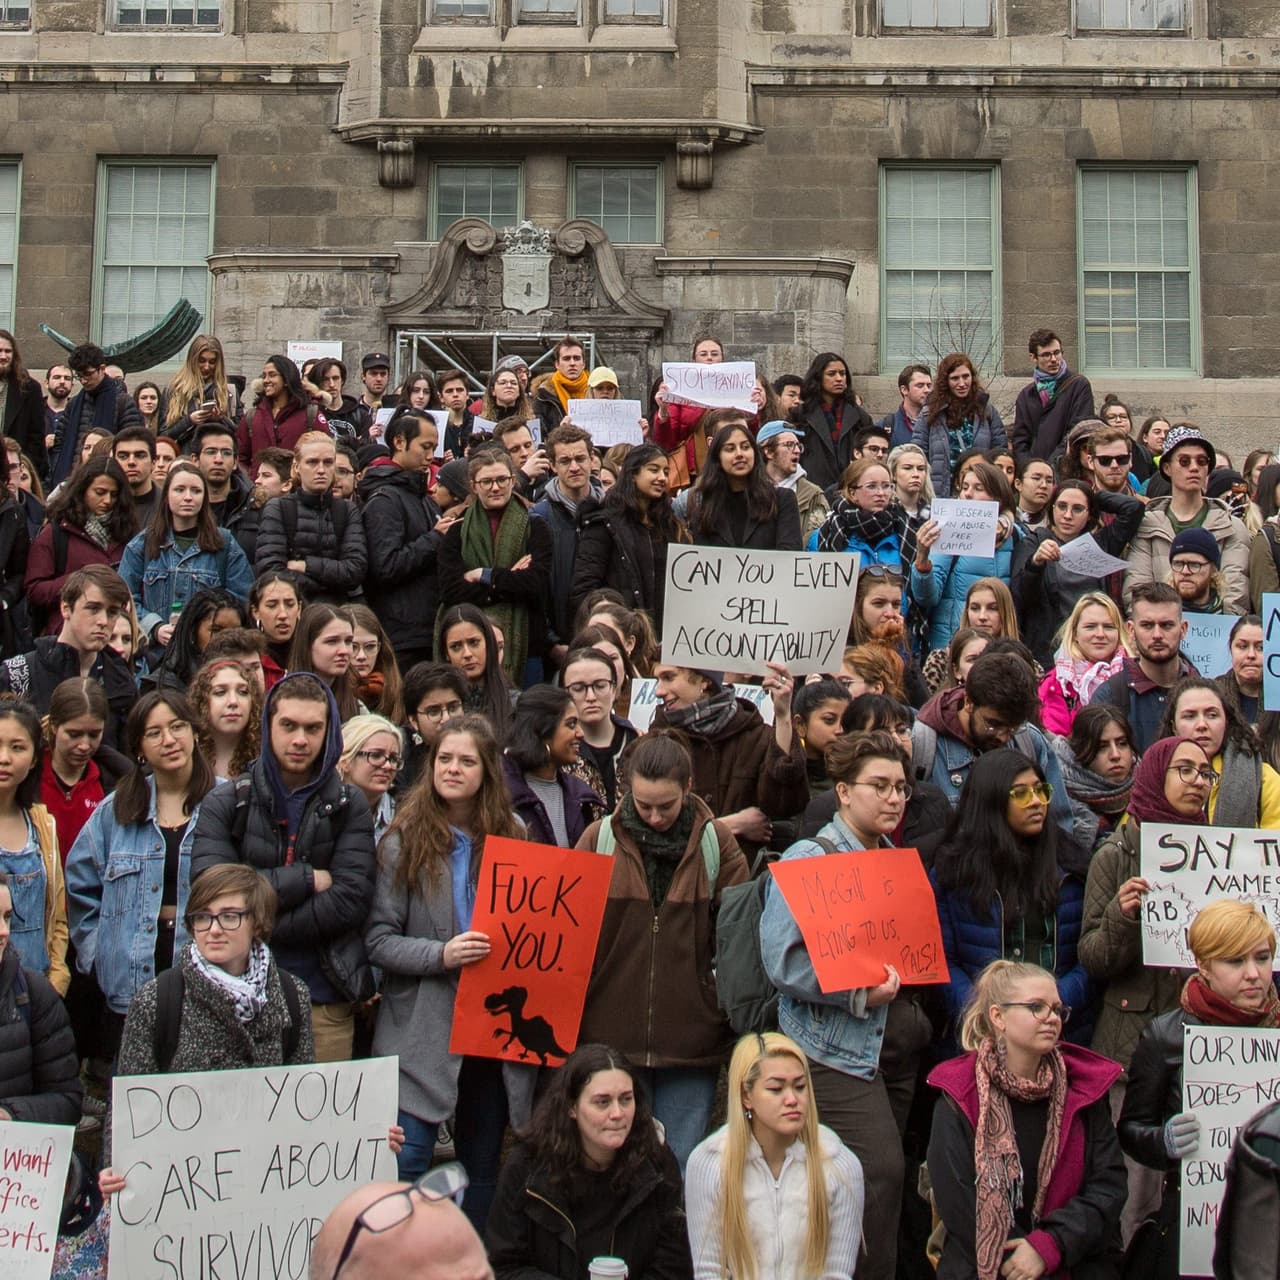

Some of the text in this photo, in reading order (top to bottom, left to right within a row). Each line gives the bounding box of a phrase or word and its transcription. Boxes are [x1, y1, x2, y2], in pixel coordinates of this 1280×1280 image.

[955, 508, 994, 519] DESERVE
[940, 542, 974, 551] CAMPUS
[671, 550, 855, 592] CAN YOU EVEN
[720, 596, 790, 626] SPELL
[671, 625, 841, 667] ACCOUNTABILITY
[1158, 833, 1235, 872] SAY
[490, 862, 582, 927] FUCK
[816, 923, 856, 960] LYING
[859, 920, 877, 945] TO
[900, 943, 938, 976] PALS!
[1189, 1035, 1235, 1066] OUR
[127, 1070, 363, 1139] DO YOU
[1186, 1083, 1241, 1109] DOES
[4, 1145, 52, 1177] want
[1186, 1160, 1227, 1187] SEXU
[117, 1138, 387, 1226] CARE ABOUT
